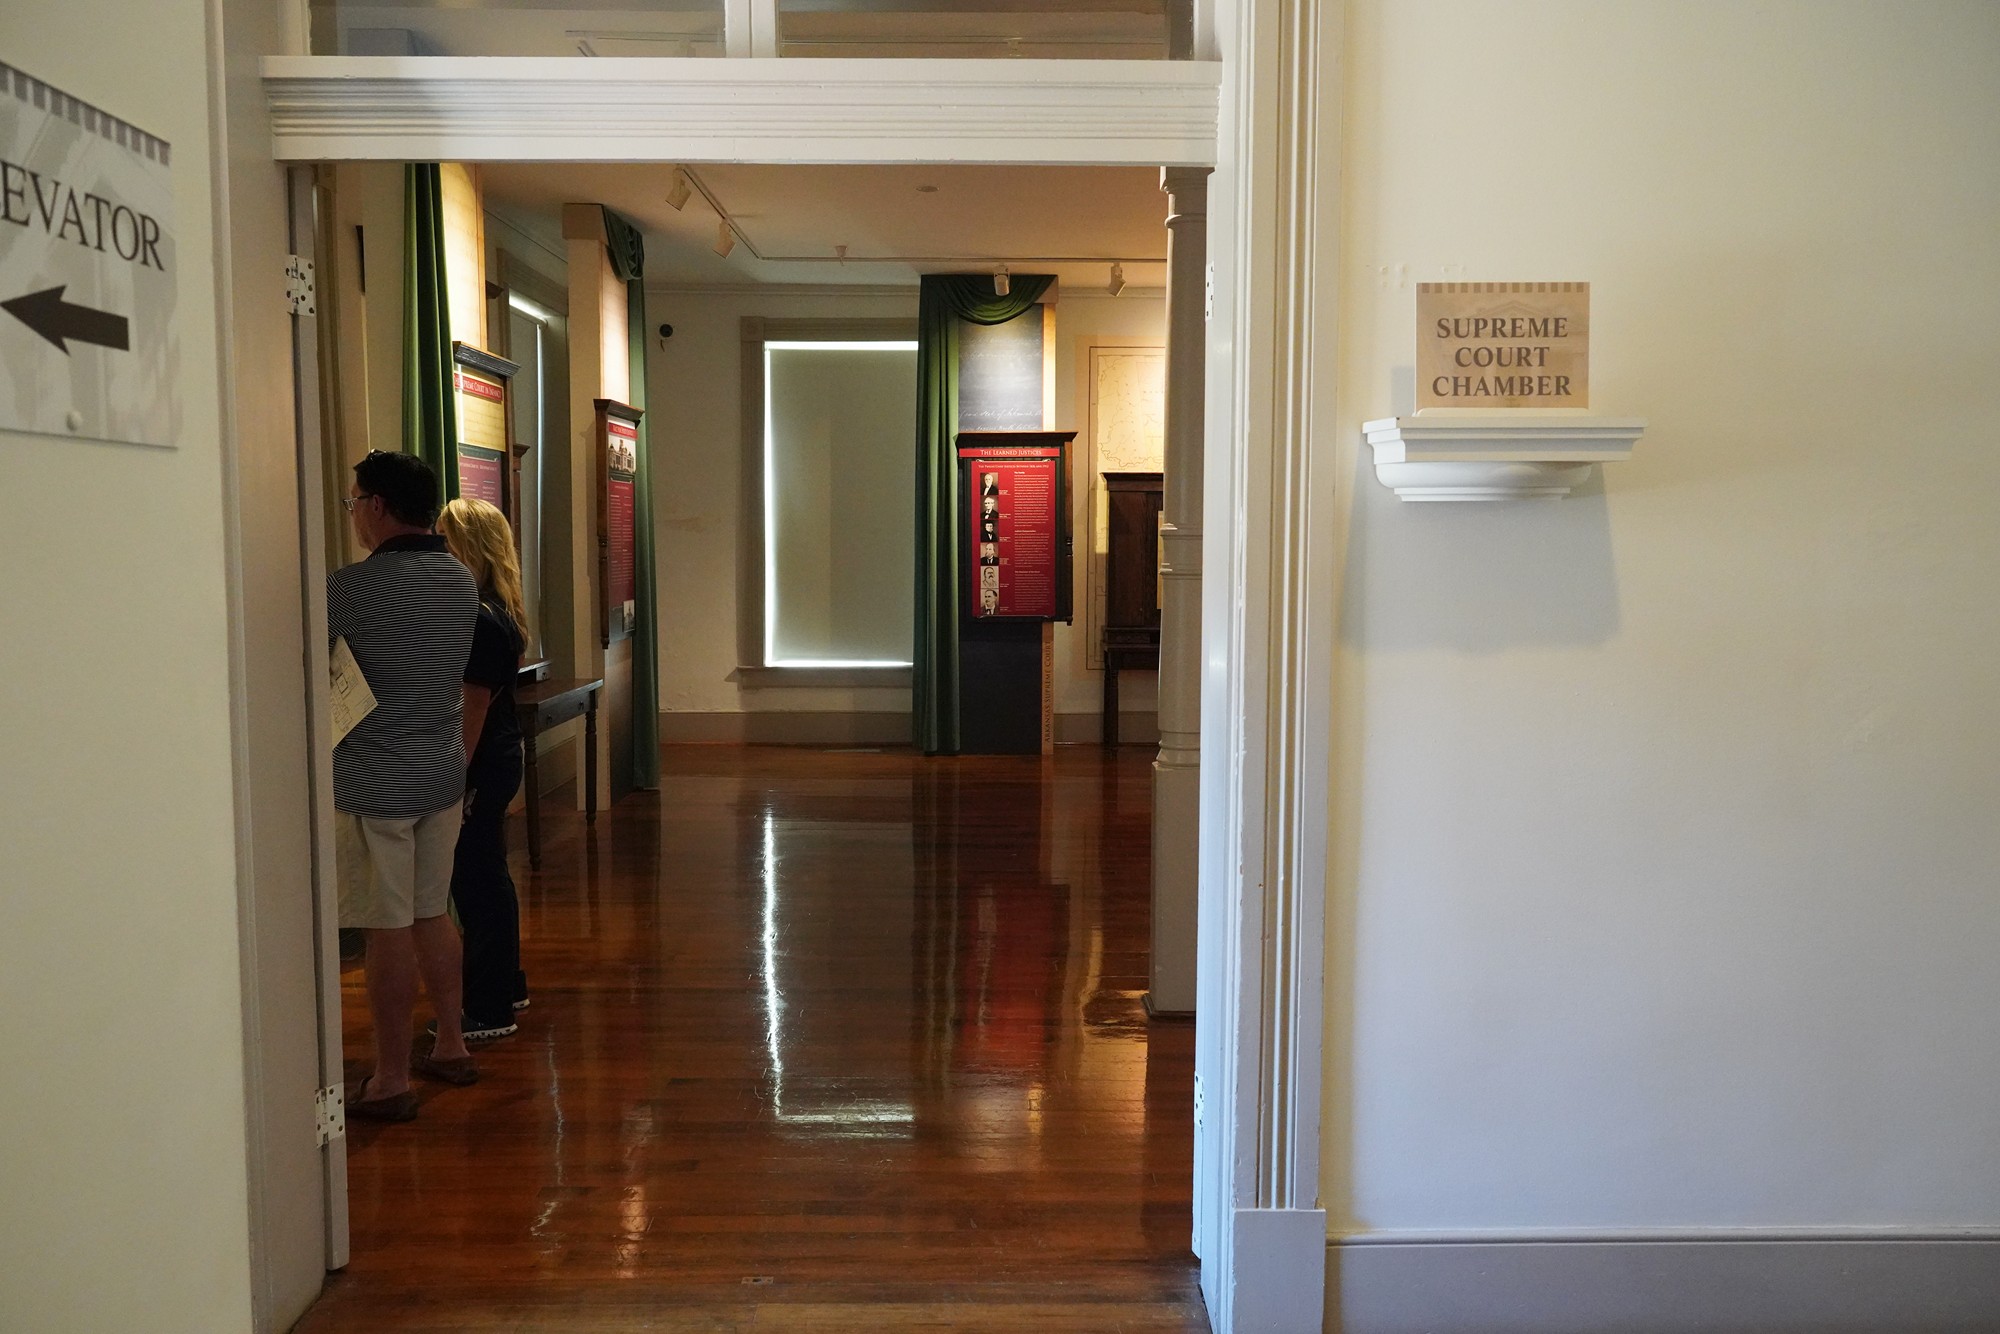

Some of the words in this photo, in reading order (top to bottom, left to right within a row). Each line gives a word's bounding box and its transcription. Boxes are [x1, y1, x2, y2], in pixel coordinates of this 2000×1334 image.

[1437, 317, 1568, 339] SUPREME
[1455, 346, 1550, 368] COURT
[1432, 375, 1572, 397] CHAMBER
